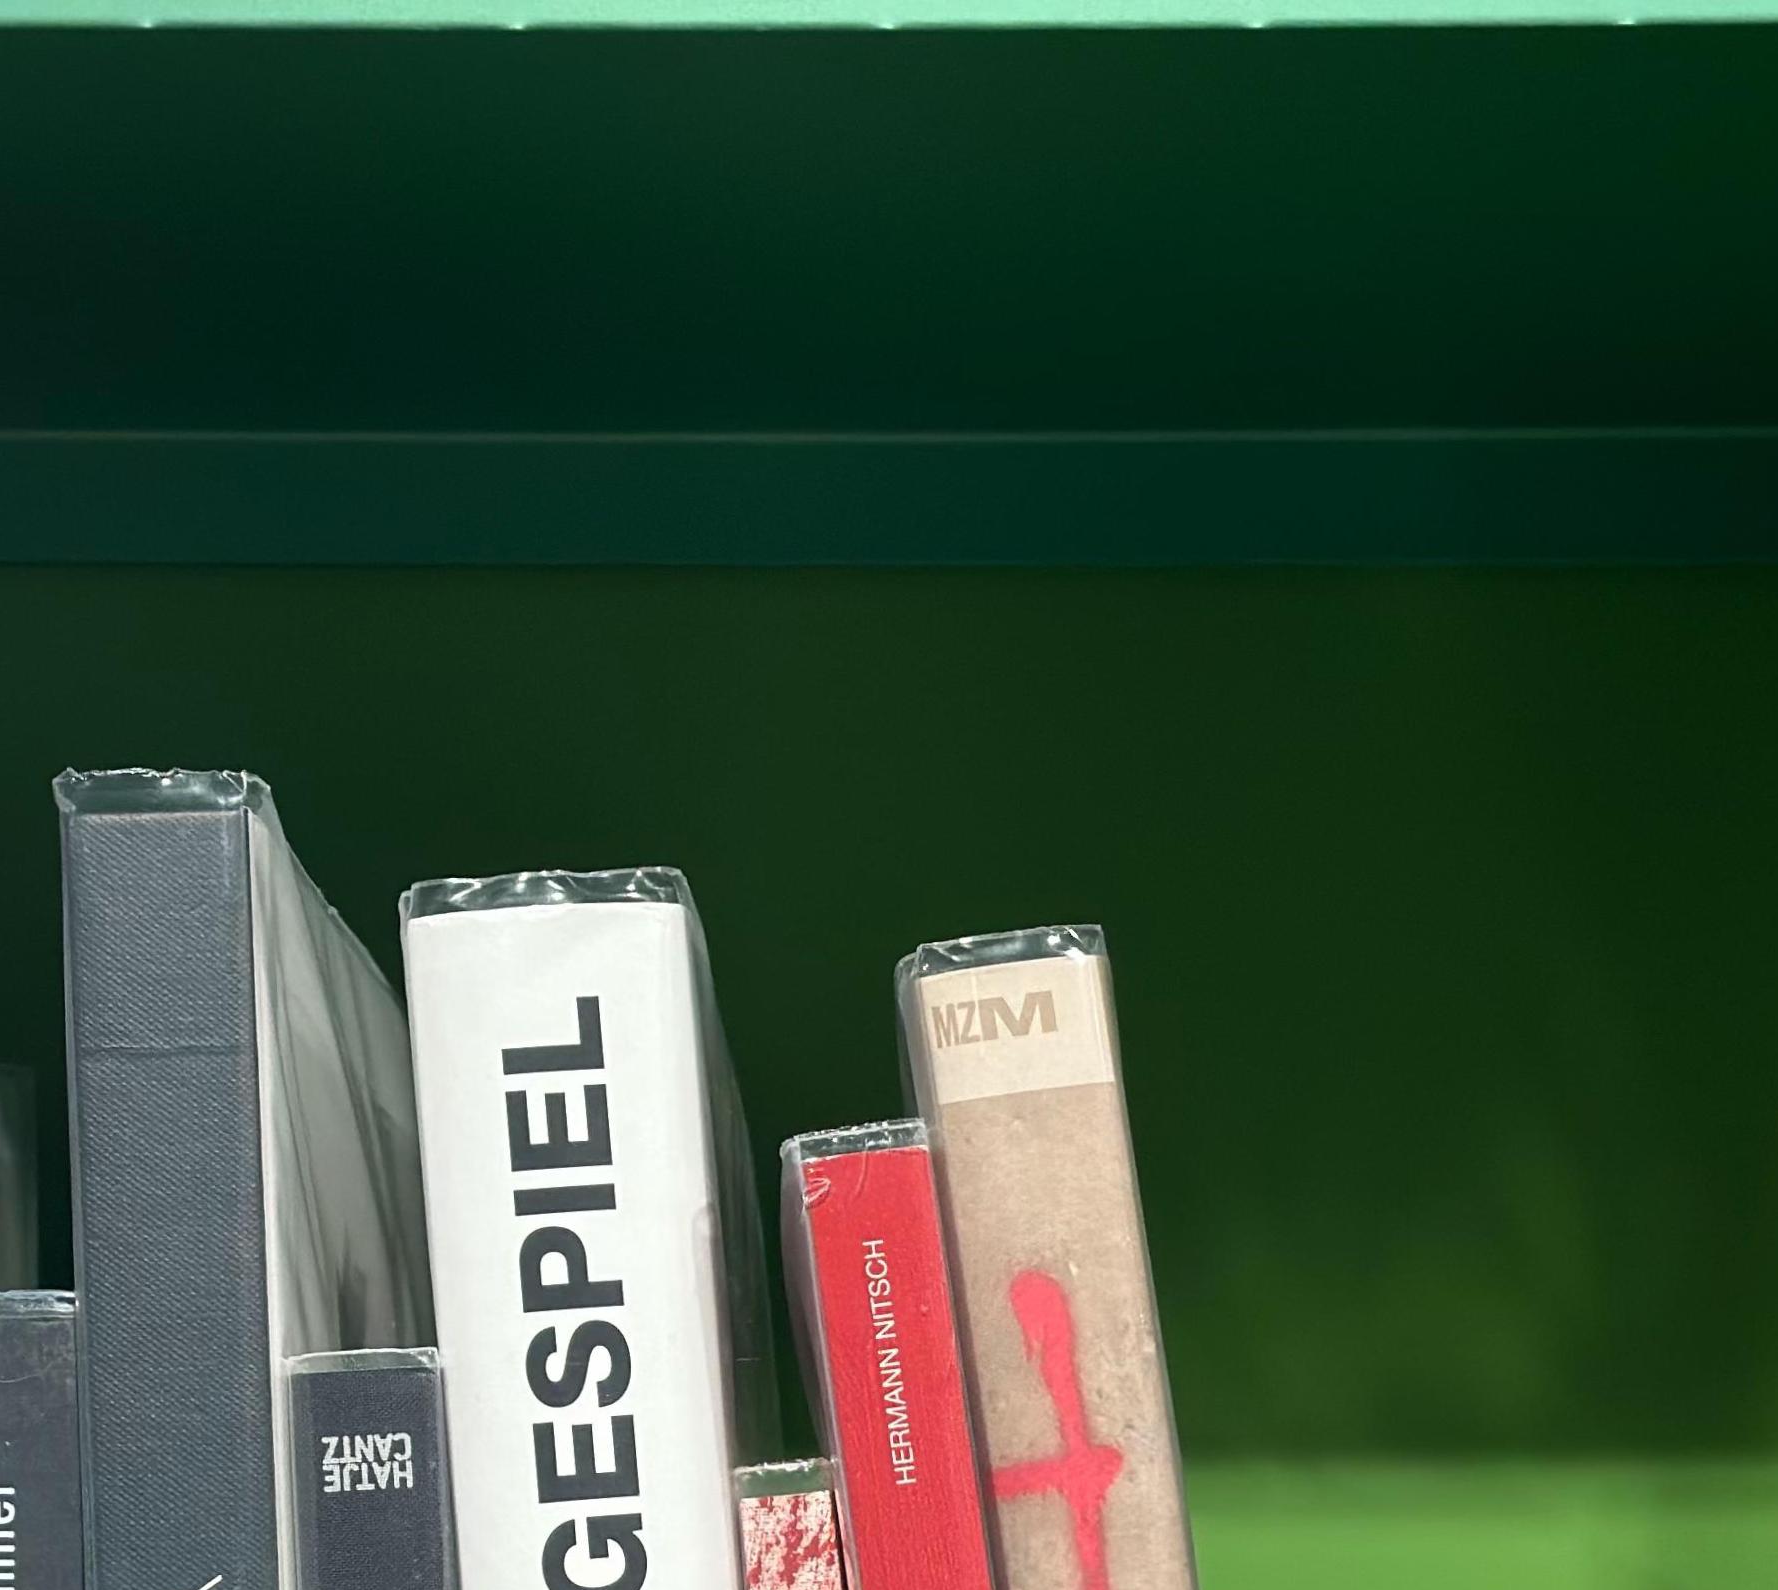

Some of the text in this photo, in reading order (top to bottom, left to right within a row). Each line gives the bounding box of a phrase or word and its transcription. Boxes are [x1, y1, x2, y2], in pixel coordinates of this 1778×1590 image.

[931, 990, 1058, 1049] MZM
[862, 1239, 916, 1485] HERMANN NITSCH
[322, 1432, 412, 1464] CANTZ
[323, 1461, 413, 1492] HATJE
